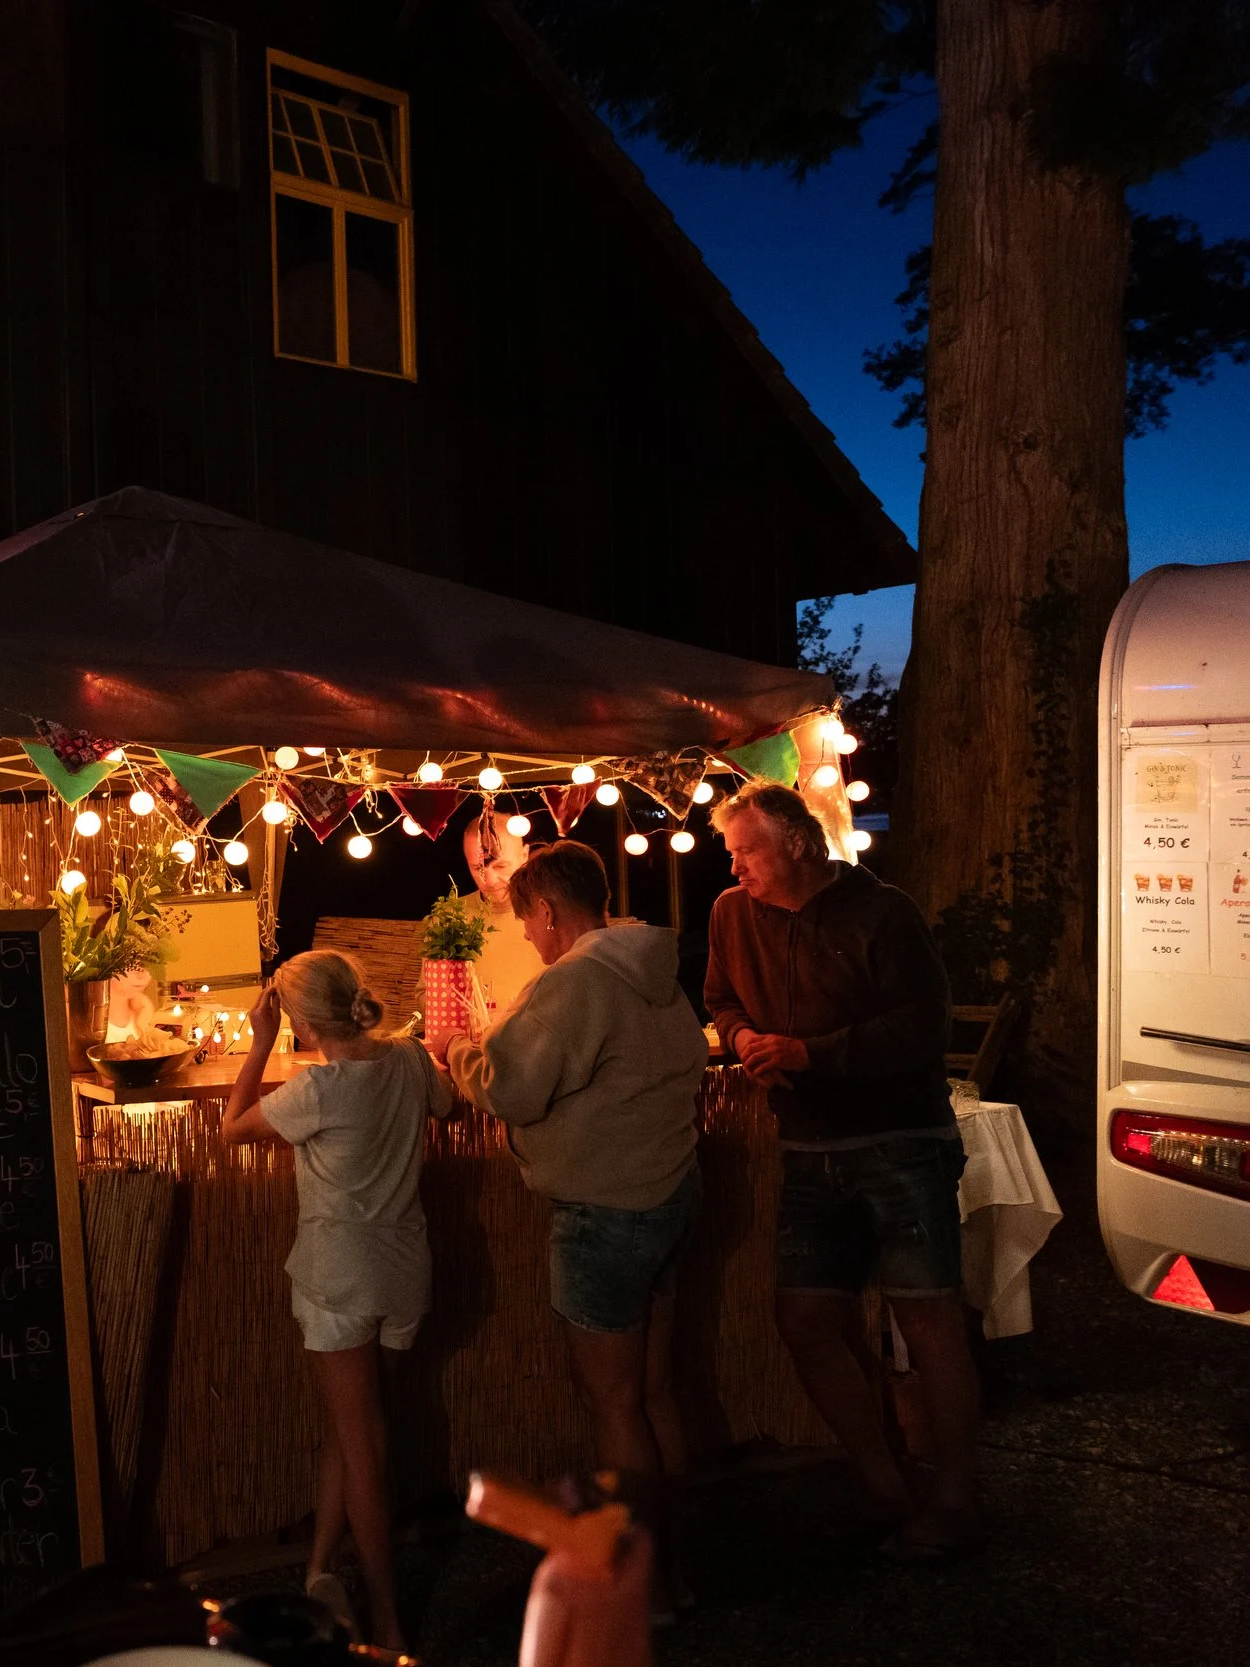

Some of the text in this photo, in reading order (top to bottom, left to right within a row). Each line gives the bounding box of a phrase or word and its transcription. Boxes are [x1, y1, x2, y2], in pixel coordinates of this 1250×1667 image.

[1143, 837, 1190, 850] 4,50 €
[1136, 896, 1195, 907] Whisky Cola
[1174, 946, 1181, 954] €
